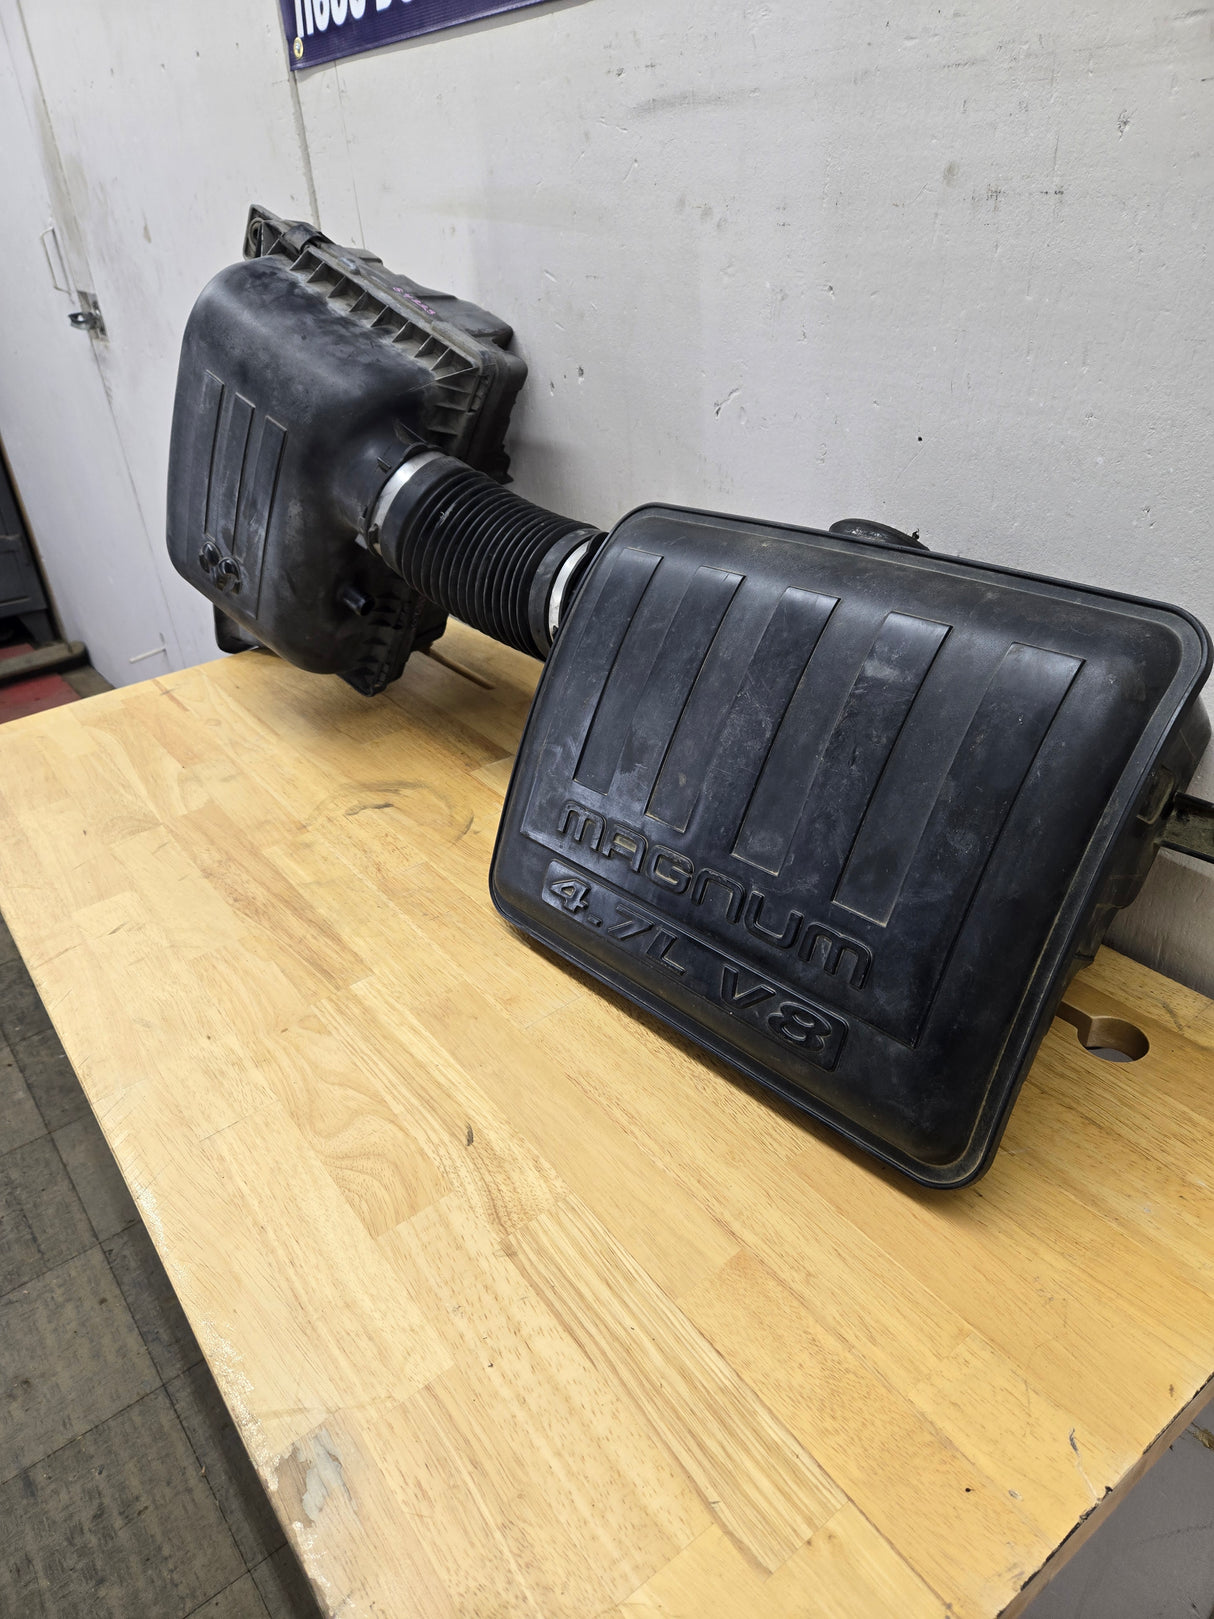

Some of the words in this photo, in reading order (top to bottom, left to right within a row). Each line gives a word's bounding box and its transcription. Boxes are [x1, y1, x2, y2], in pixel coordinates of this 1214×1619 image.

[549, 876, 688, 977] 4.7L
[719, 964, 833, 1053] V8
[556, 799, 874, 992] MAGNUM
